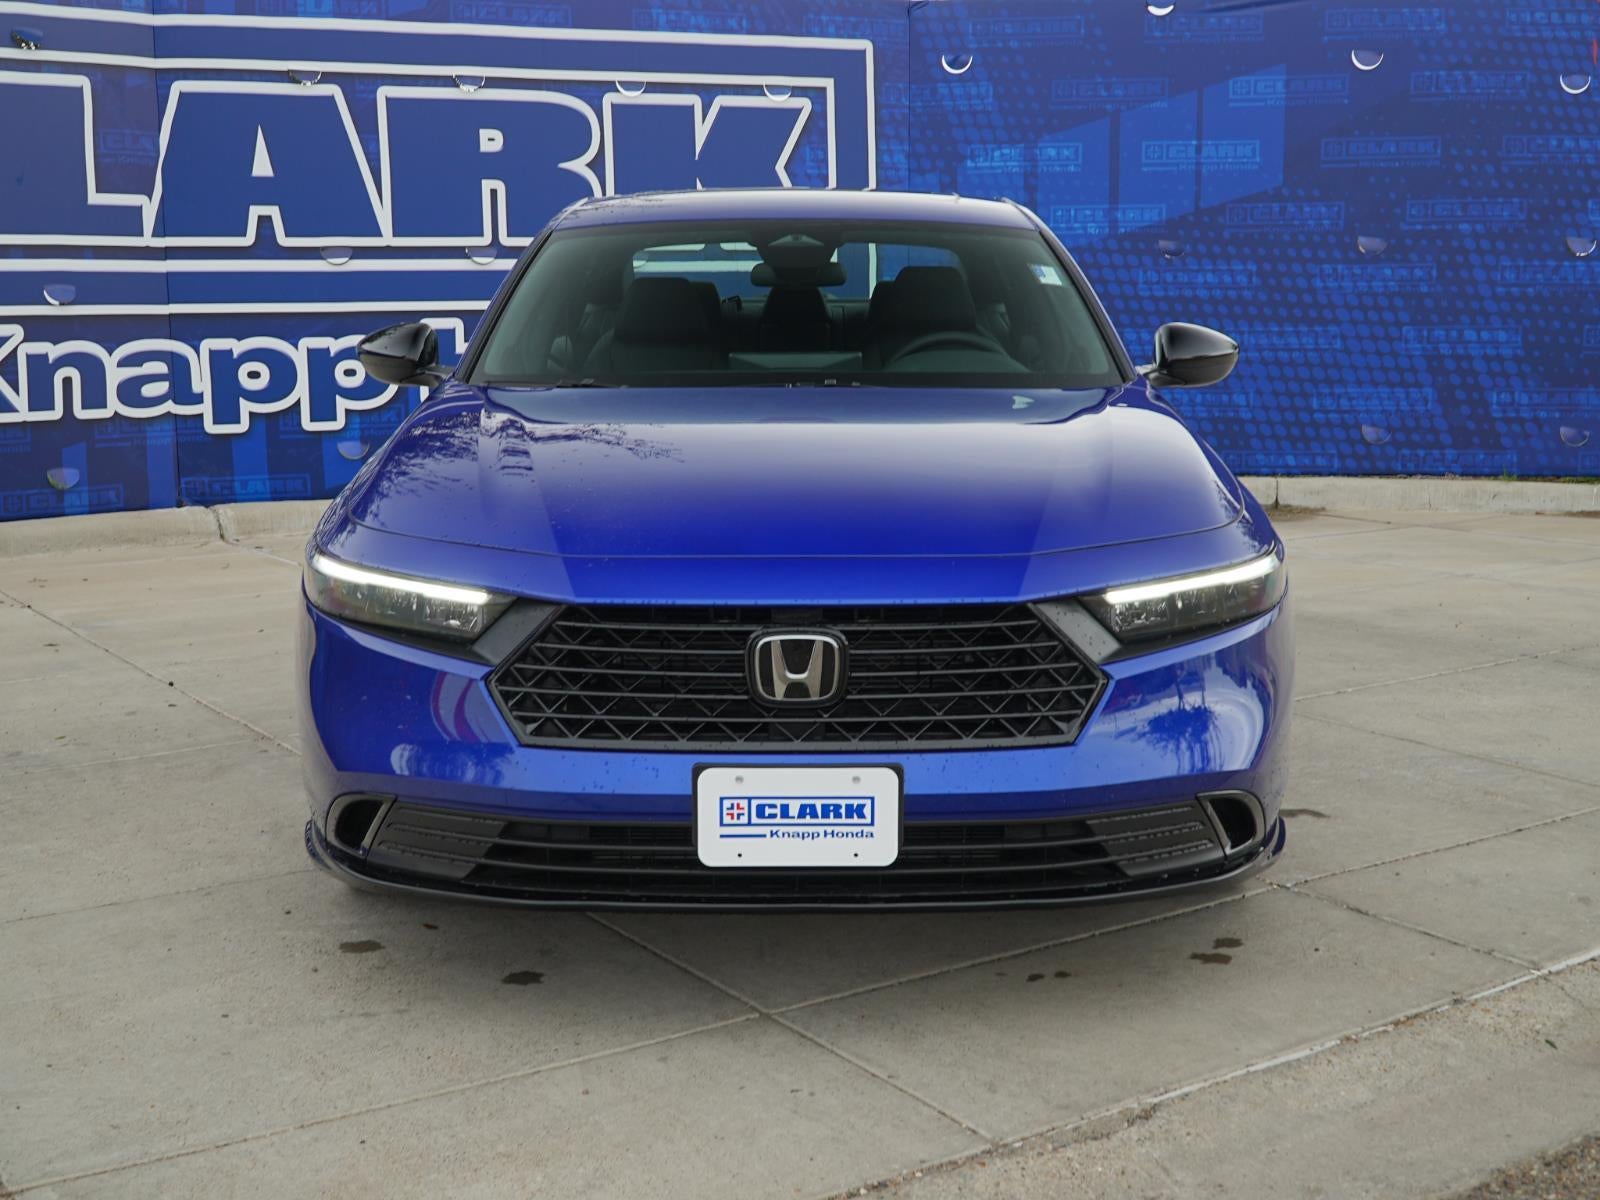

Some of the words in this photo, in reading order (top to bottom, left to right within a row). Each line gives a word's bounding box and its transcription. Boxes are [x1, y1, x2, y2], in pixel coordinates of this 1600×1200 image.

[755, 803, 867, 820] CLARK
[769, 829, 820, 841] Knapp
[823, 829, 874, 839] Honda
